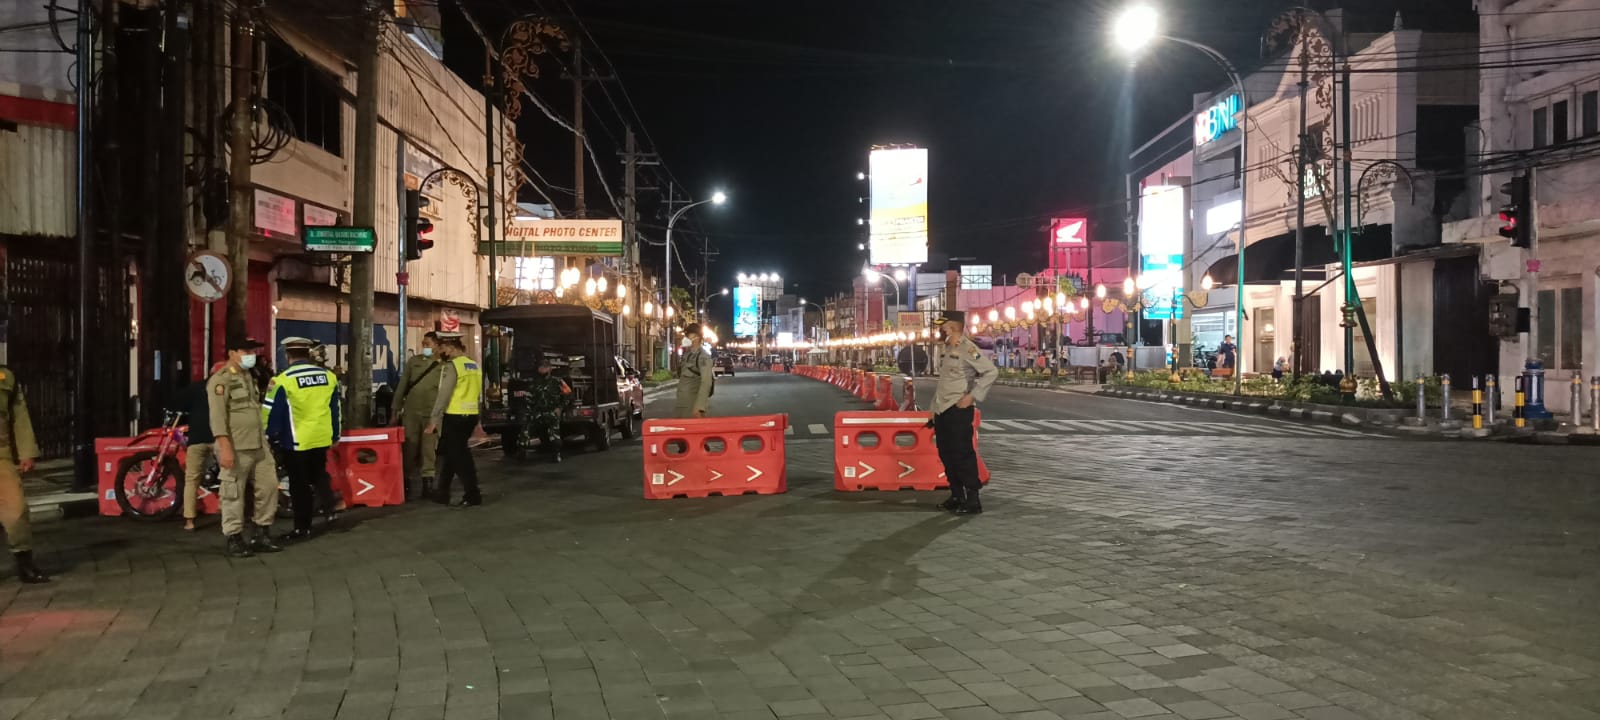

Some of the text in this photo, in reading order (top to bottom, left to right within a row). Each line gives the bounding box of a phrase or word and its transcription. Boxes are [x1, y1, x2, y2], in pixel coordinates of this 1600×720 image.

[1208, 94, 1238, 139] BNI
[543, 227, 576, 237] PHOTO
[579, 227, 617, 237] CENTER
[298, 375, 327, 387] POLISI
